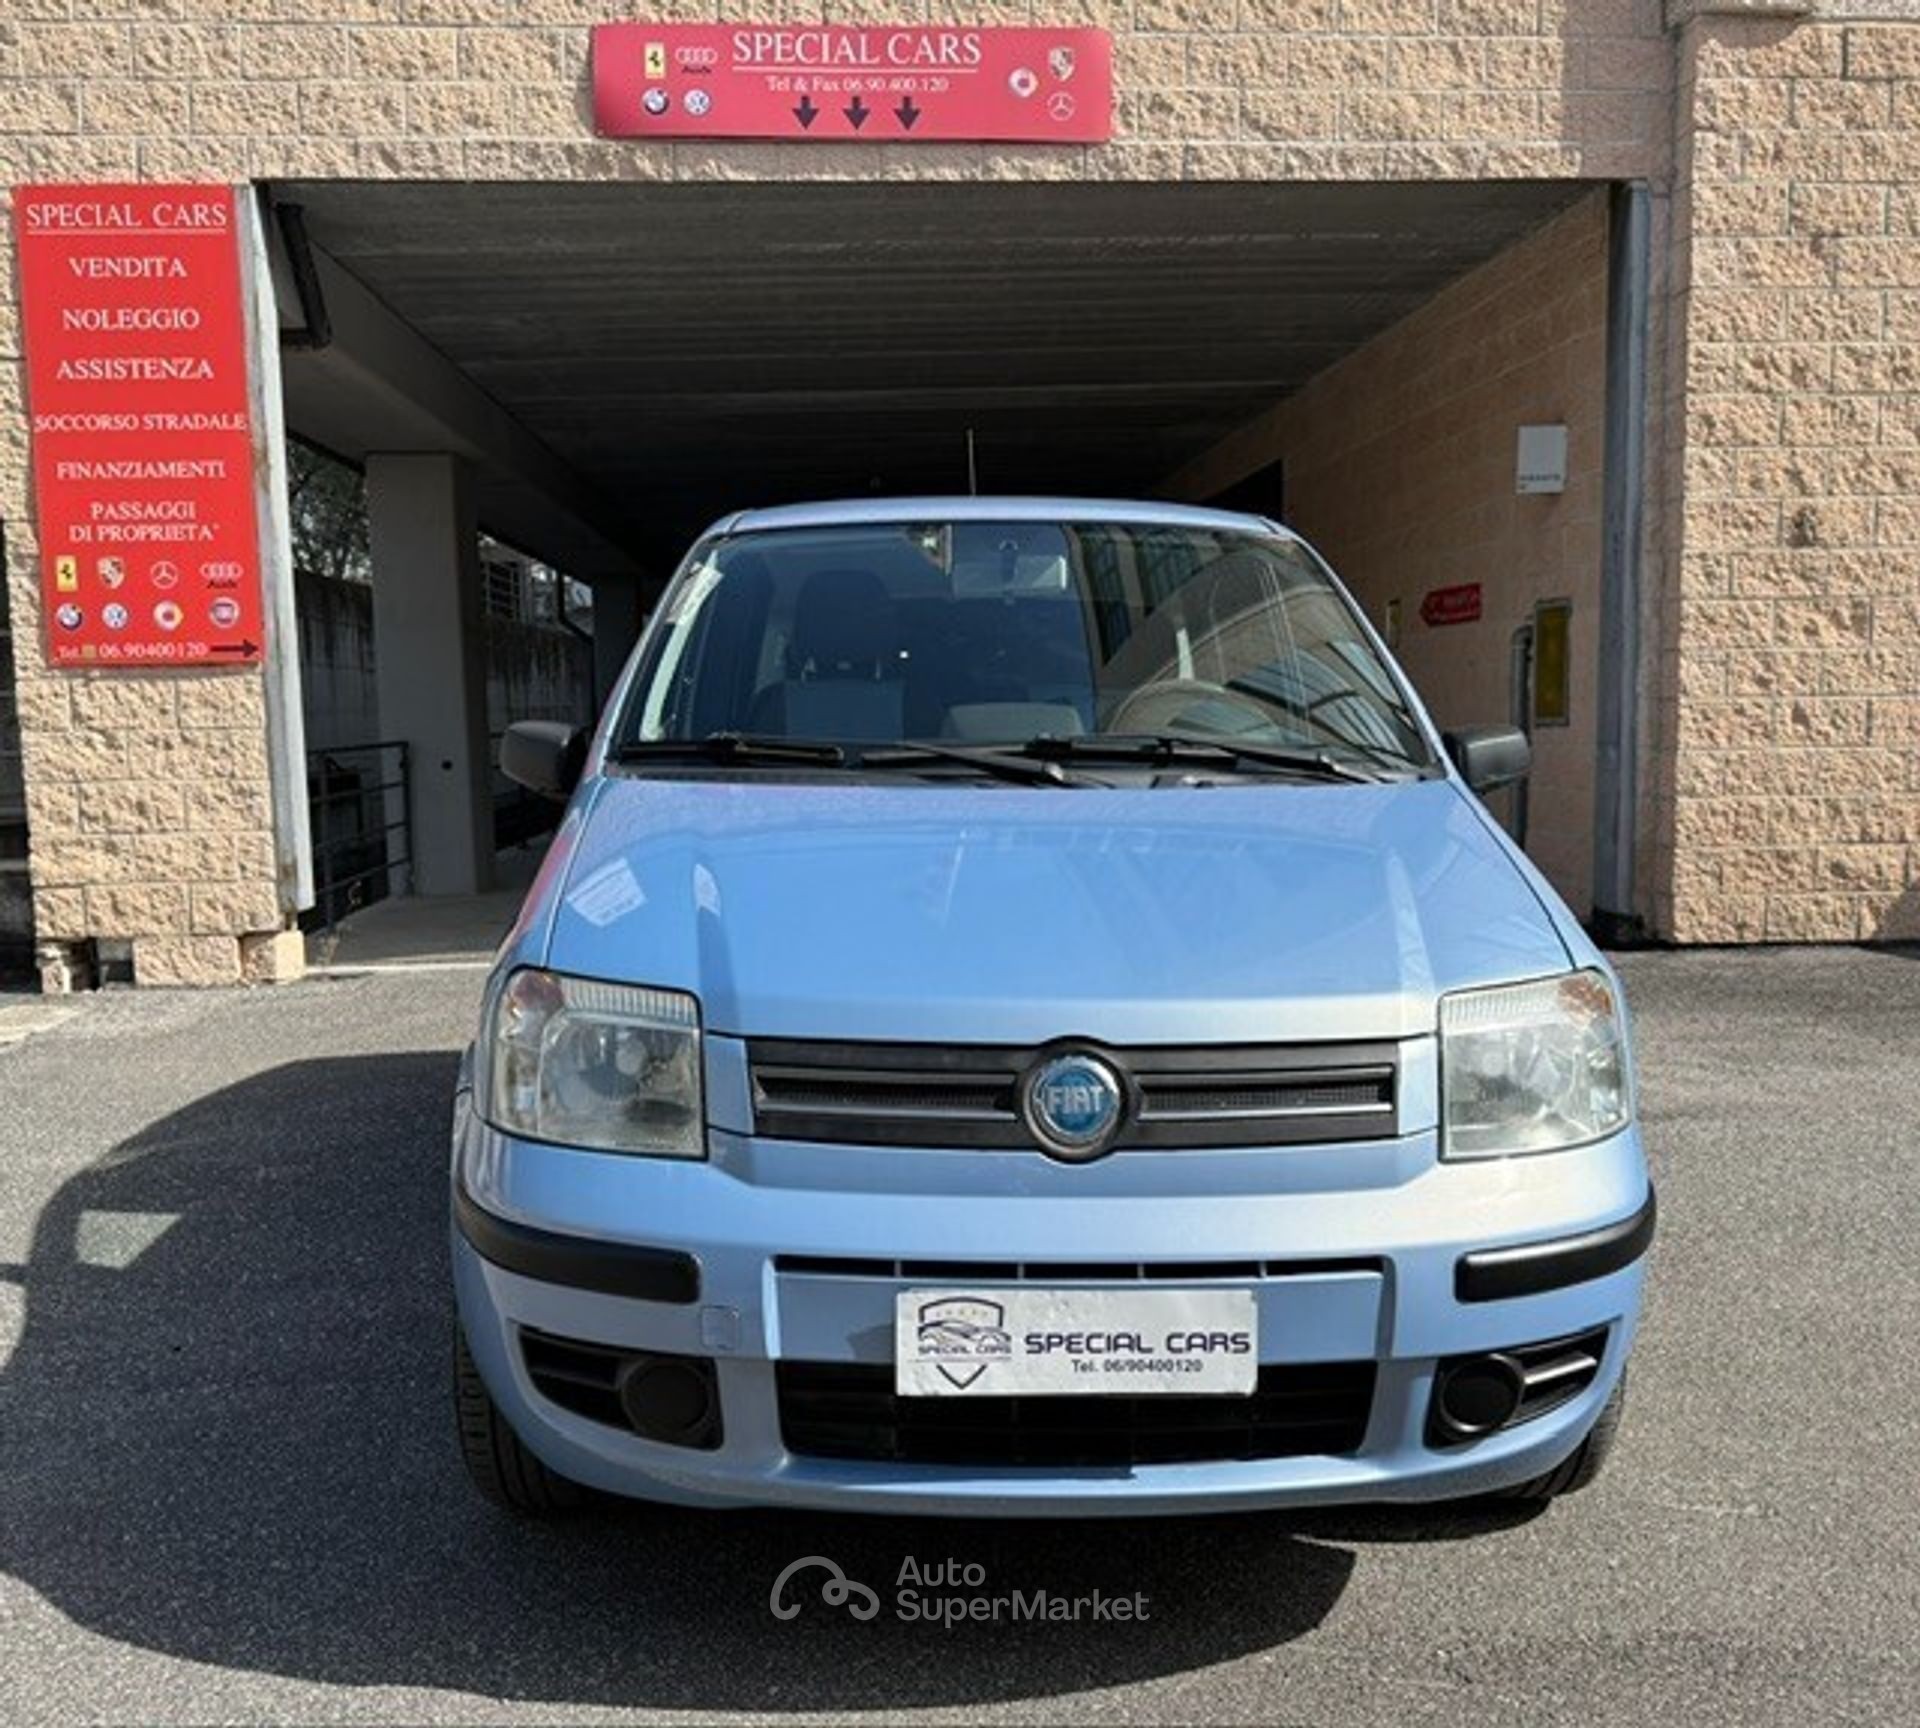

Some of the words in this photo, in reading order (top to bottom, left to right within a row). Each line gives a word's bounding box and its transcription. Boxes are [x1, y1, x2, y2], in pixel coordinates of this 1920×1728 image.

[732, 32, 881, 65] SPECIAL
[887, 33, 982, 65] CARS
[766, 76, 791, 92] Tel
[794, 76, 809, 92] &
[812, 77, 840, 92] Fax
[26, 203, 141, 228] SPECIAL
[152, 202, 228, 227] CARS
[69, 257, 187, 278] VENDITA
[62, 308, 200, 331] NOLEGGIO
[56, 358, 214, 380] ASSISTENZA
[35, 415, 139, 431] SOCCORSO
[144, 413, 247, 430] STRADALE
[56, 461, 226, 480] FINANZIAMENTI
[90, 501, 196, 520] PASSAGGI
[68, 526, 92, 542] DI
[1047, 1085, 1105, 1114] FIAT
[1024, 1332, 1153, 1354] SPECIAL
[1166, 1332, 1251, 1354] CARS
[1071, 1359, 1098, 1372] Tel.
